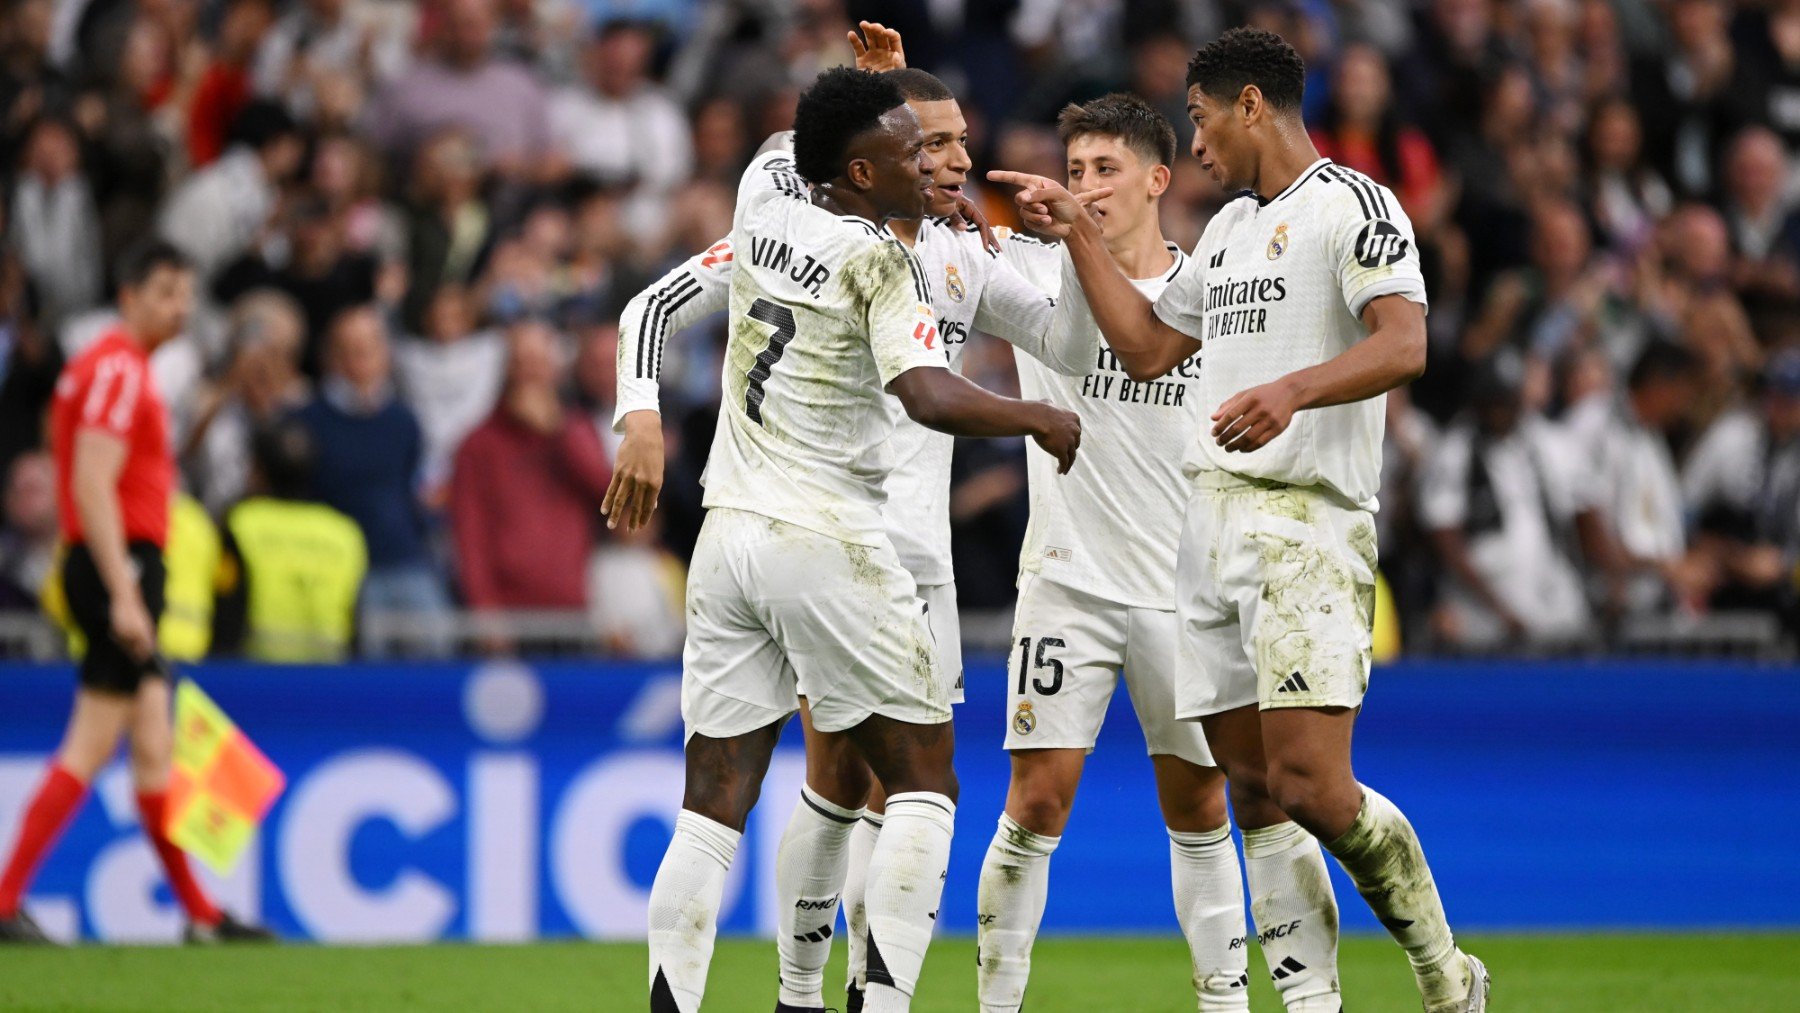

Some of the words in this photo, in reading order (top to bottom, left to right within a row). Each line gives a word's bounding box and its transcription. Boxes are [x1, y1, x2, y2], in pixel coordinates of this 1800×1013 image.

[1355, 221, 1409, 268] hp
[790, 254, 831, 300] JR.
[1220, 308, 1267, 337] BETTER
[745, 297, 797, 427] 7
[1082, 374, 1114, 400] FLY
[1119, 378, 1186, 407] BETTER
[1018, 636, 1066, 696] 15
